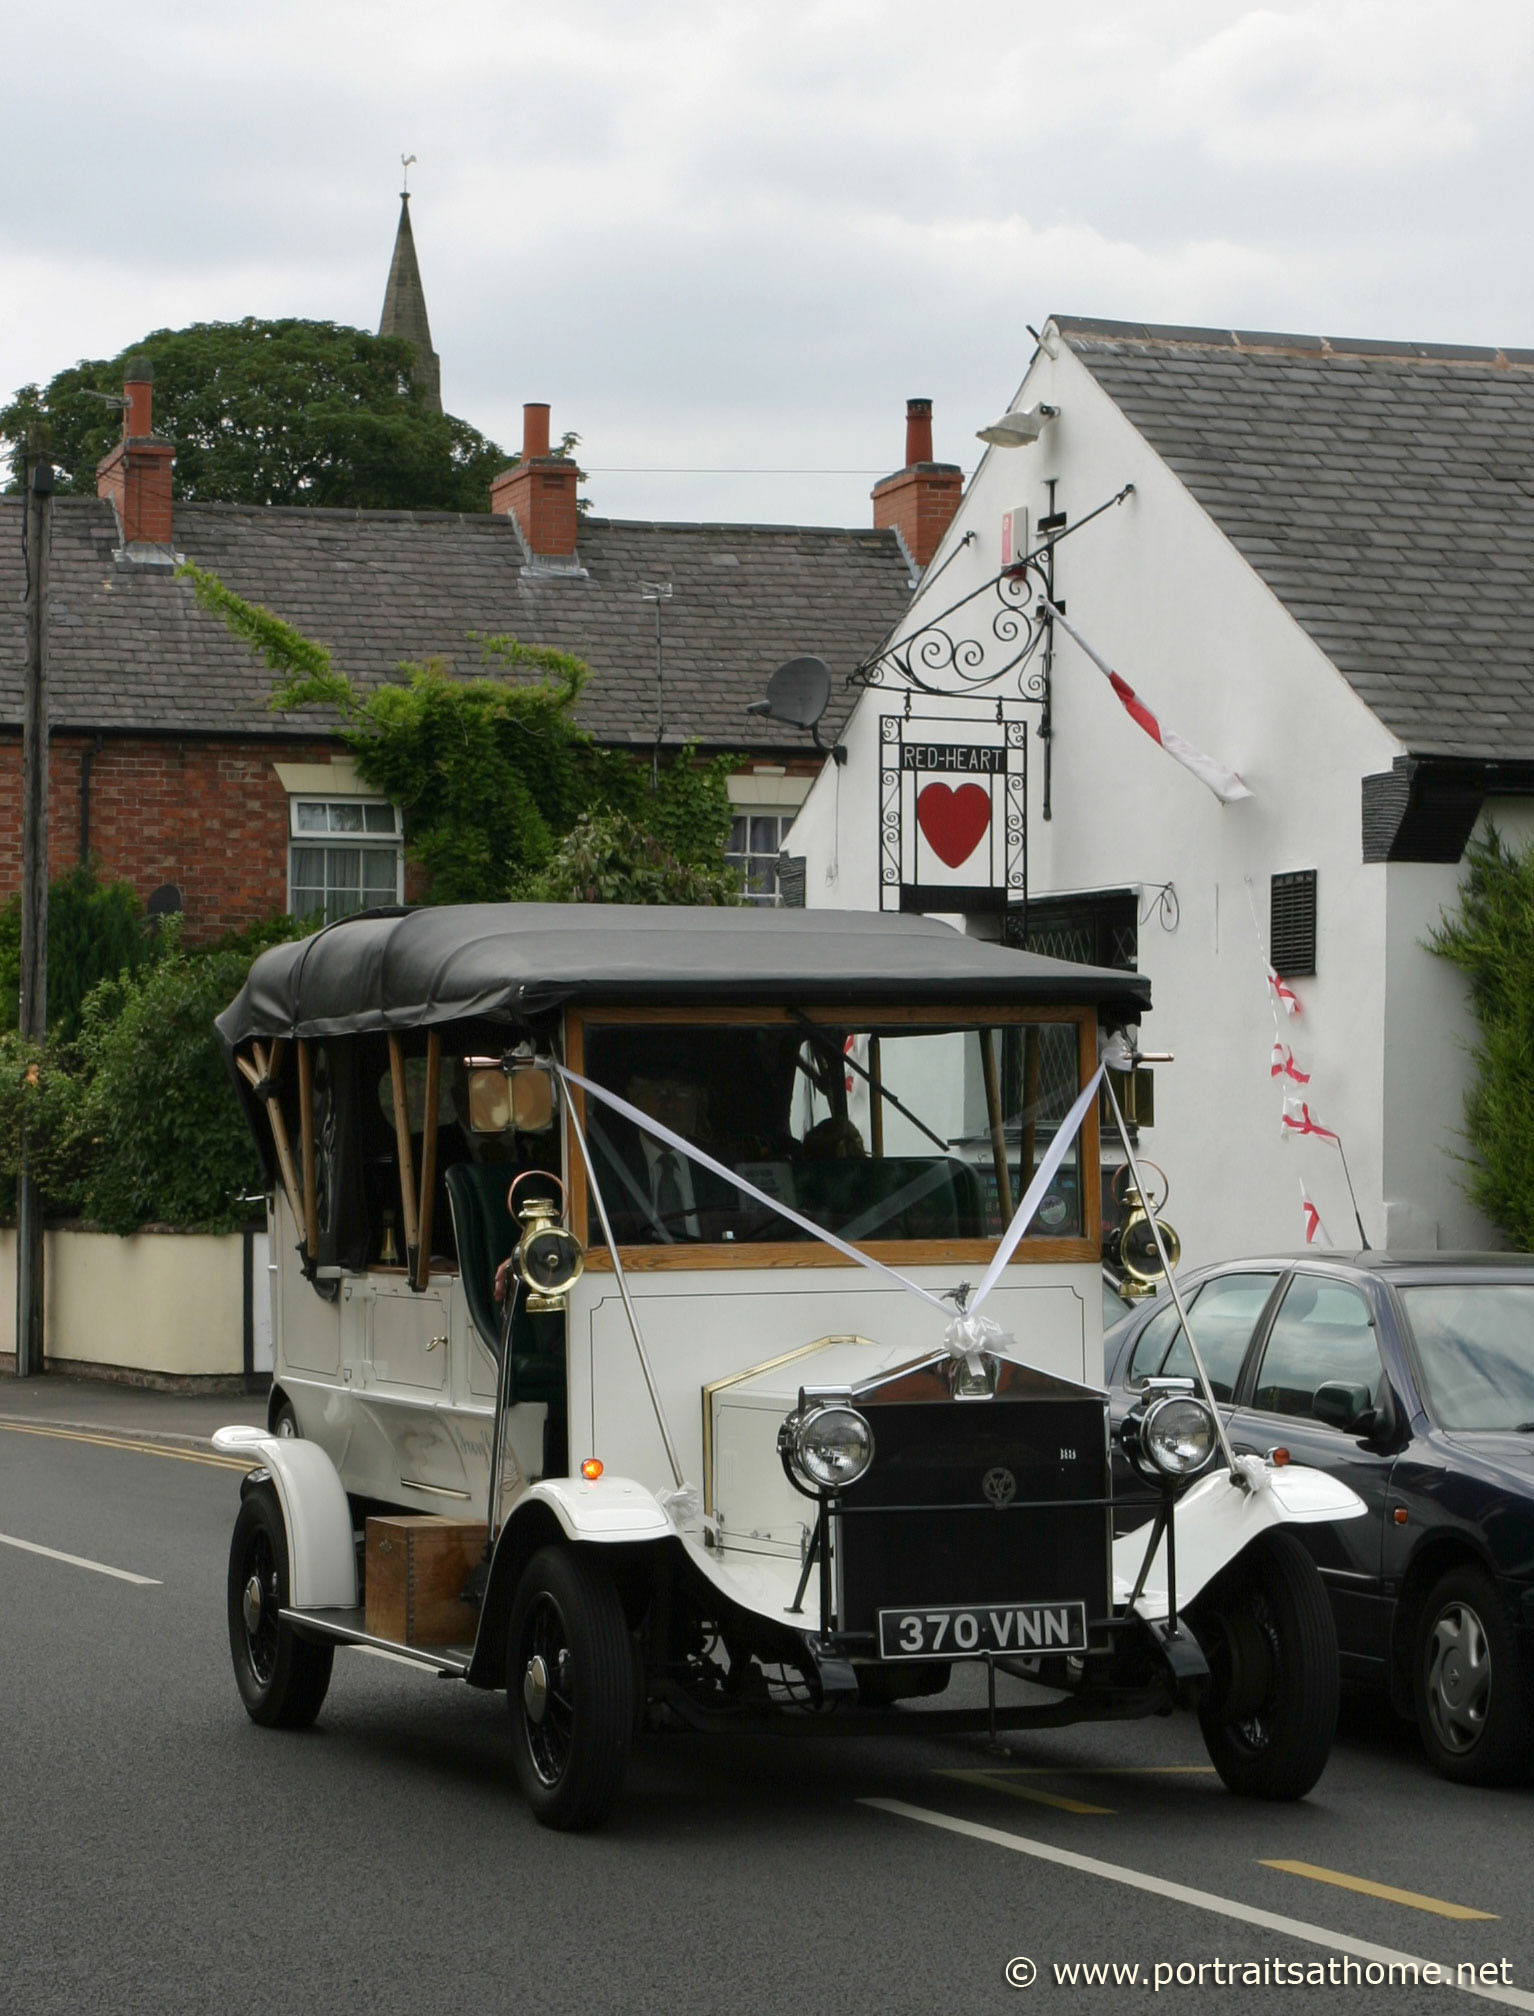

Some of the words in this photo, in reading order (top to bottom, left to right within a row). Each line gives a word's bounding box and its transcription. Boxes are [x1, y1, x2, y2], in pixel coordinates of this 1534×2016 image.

[904, 746, 1003, 771] RED-HEART
[899, 1613, 979, 1652] 370
[989, 1608, 1070, 1648] VNN
